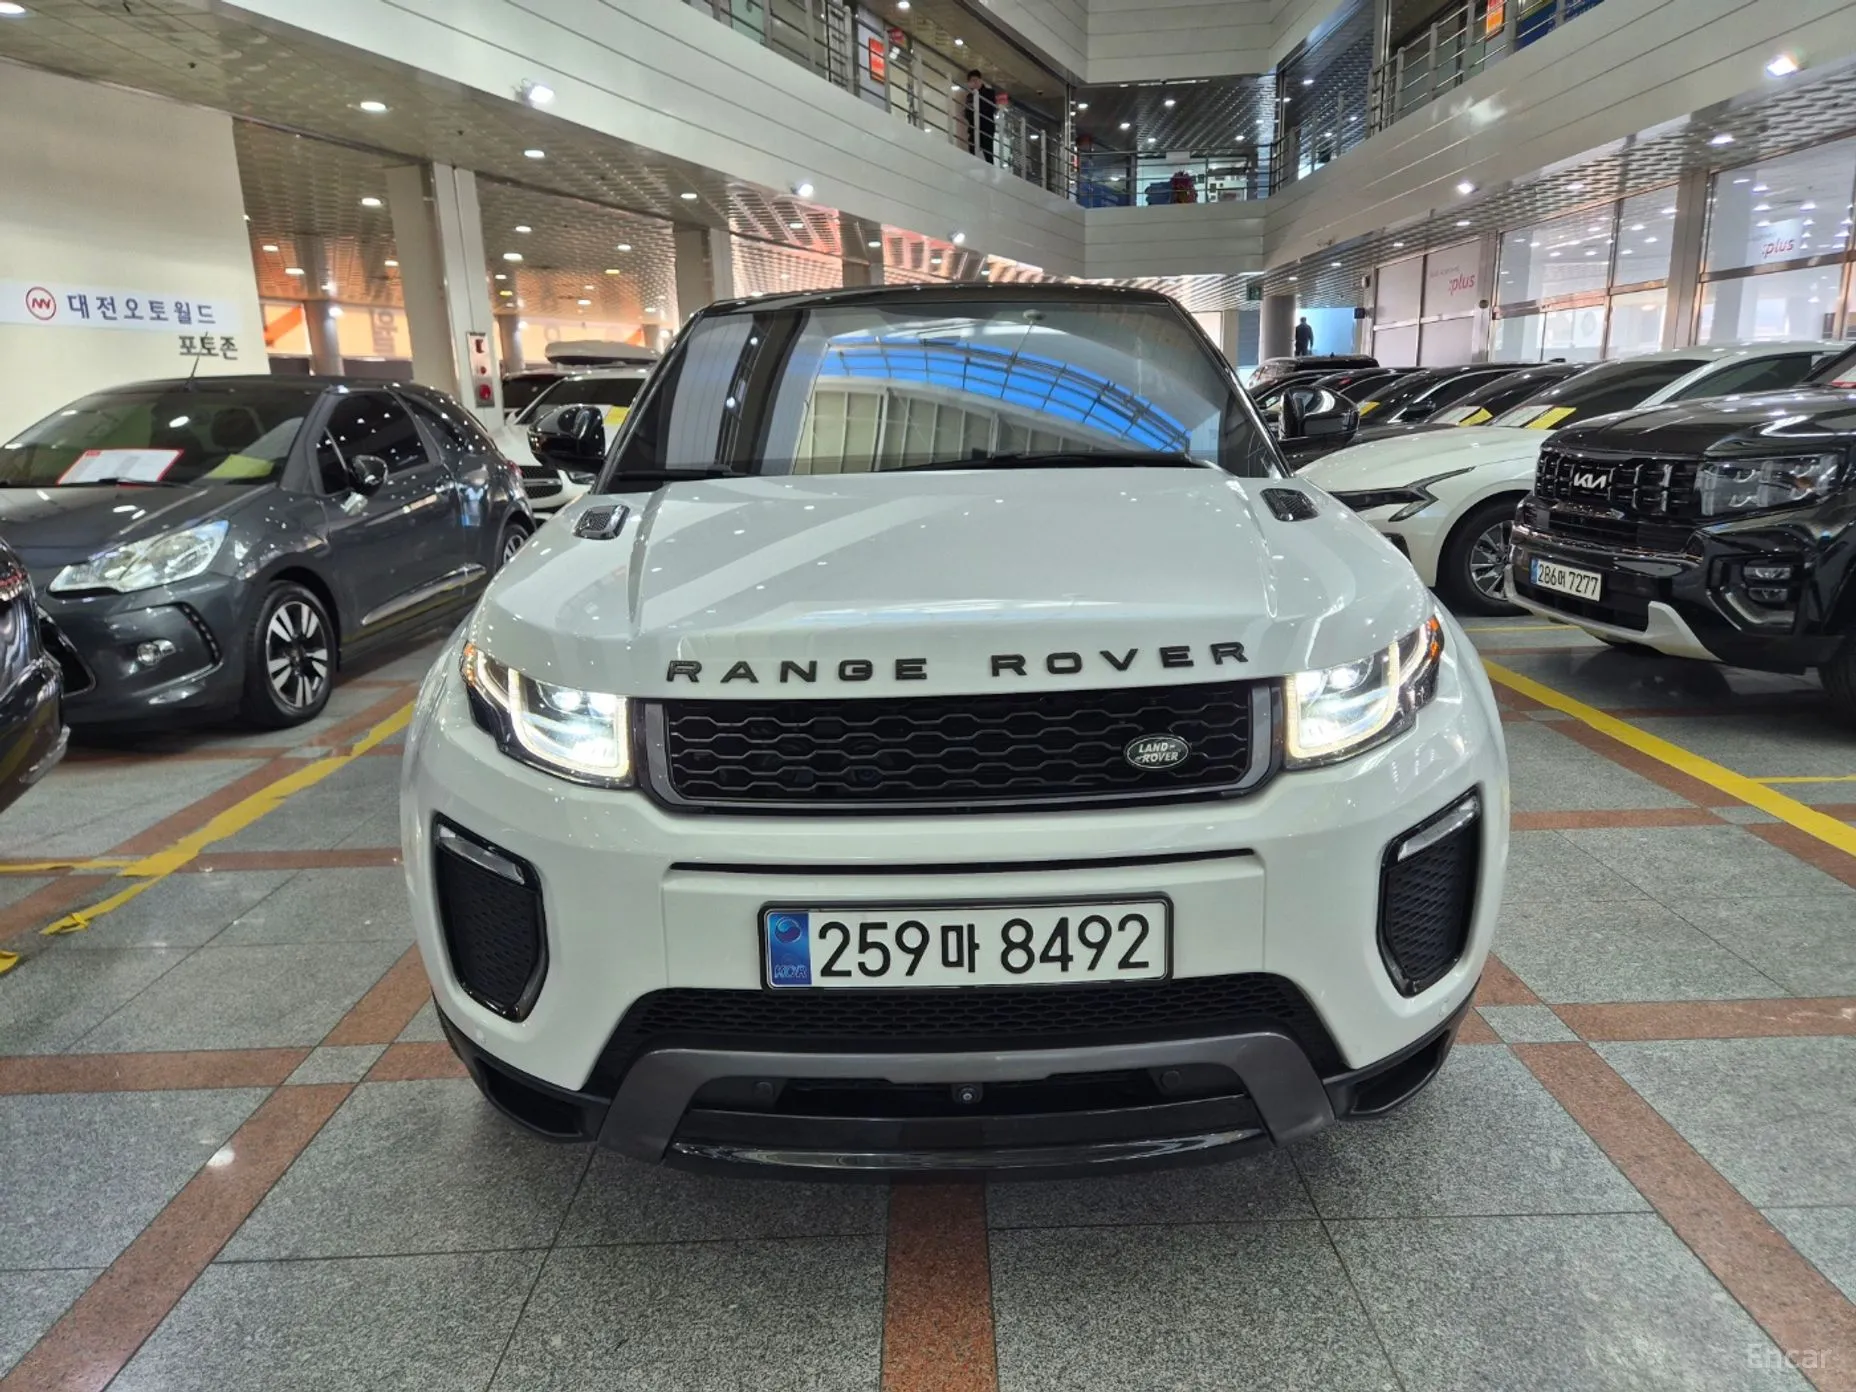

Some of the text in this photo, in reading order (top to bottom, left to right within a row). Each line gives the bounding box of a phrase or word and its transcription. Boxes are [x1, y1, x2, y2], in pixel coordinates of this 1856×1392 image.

[67, 293, 216, 325] 대전오토월드
[178, 335, 238, 360] 포토존
[1573, 472, 1607, 489] KIA
[1568, 571, 1599, 597] 7277
[666, 641, 1249, 684] RANGE ROVER
[818, 913, 1150, 978] 259마 8492
